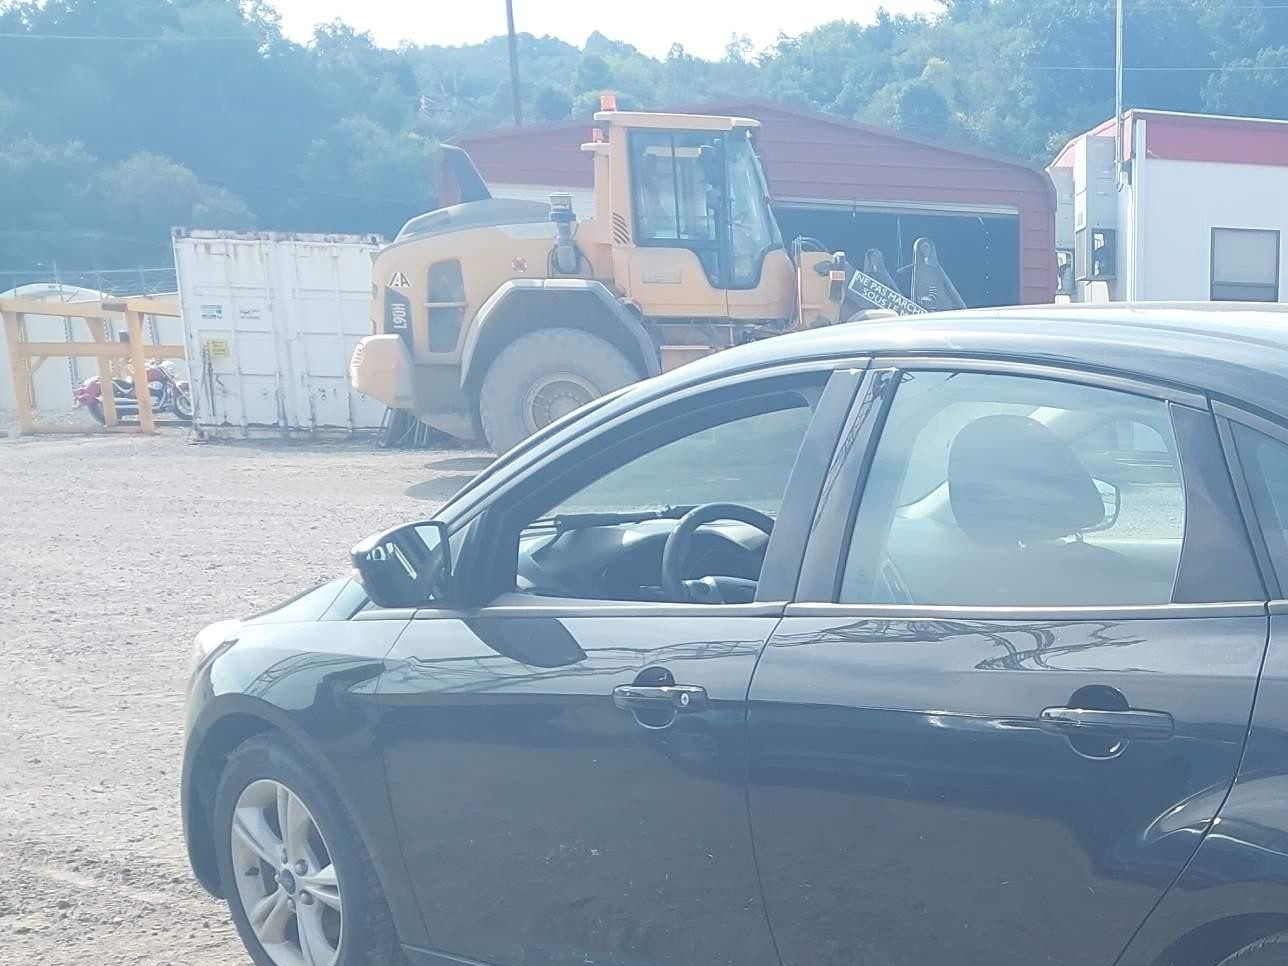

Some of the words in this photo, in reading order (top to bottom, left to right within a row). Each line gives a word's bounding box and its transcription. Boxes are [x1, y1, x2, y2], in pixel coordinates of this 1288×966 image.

[856, 274, 869, 287] NE
[870, 282, 888, 296] PAS
[888, 292, 926, 316] MARCH
[863, 288, 887, 306] SOUS
